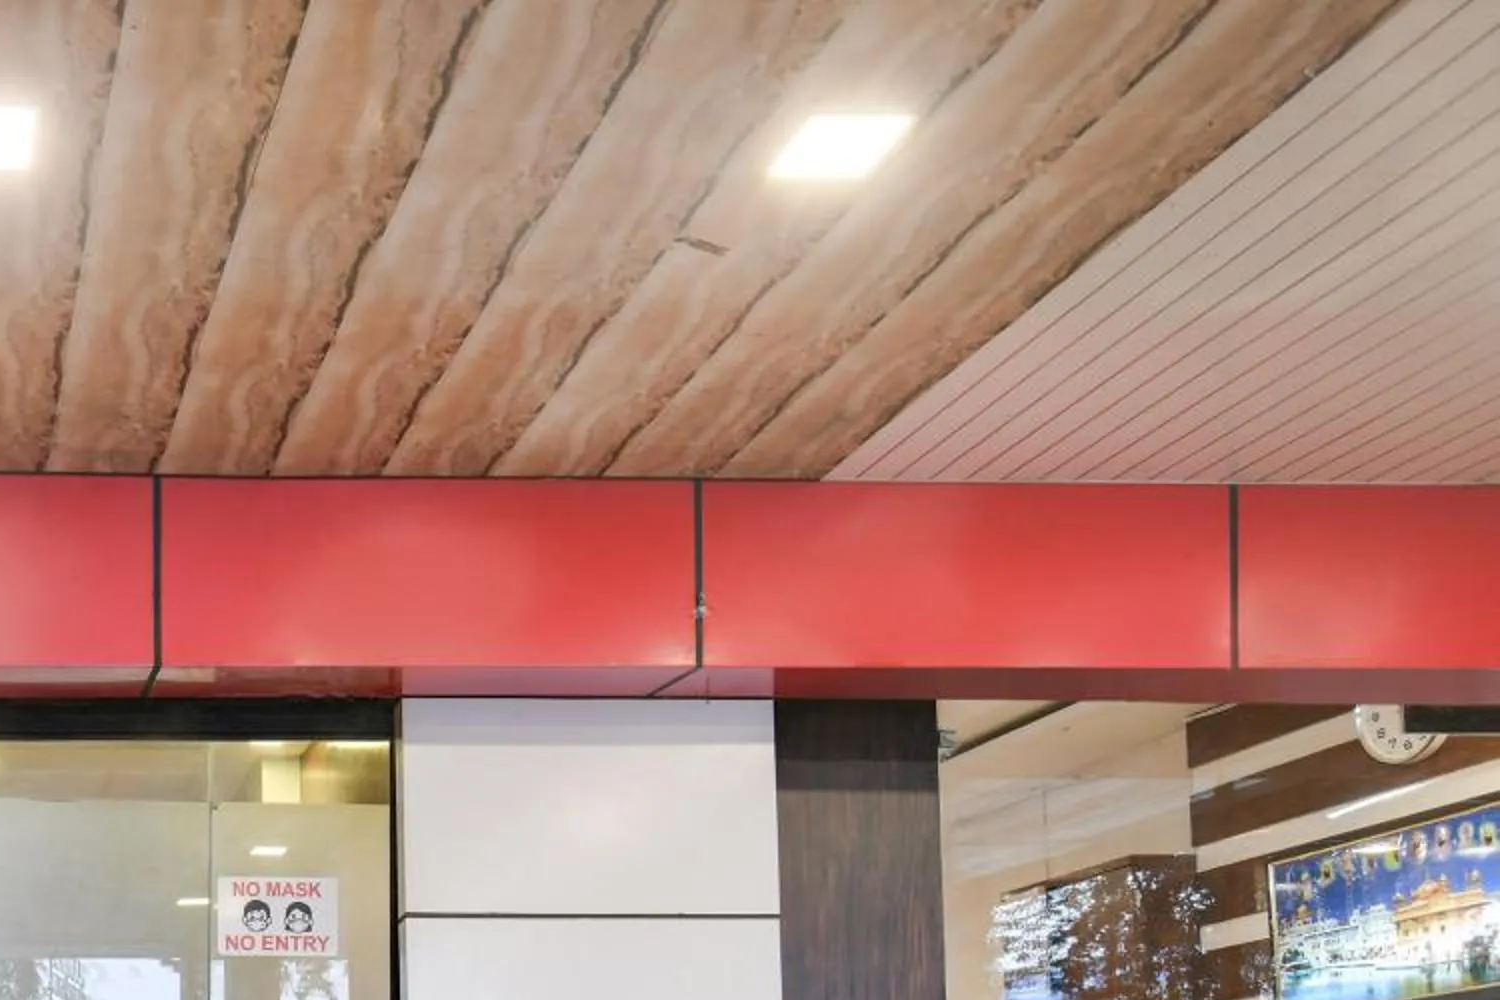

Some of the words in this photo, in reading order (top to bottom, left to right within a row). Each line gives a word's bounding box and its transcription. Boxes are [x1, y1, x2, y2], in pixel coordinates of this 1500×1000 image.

[232, 881, 260, 897] NO
[266, 881, 323, 898] MASK
[225, 935, 256, 951] NO
[261, 935, 330, 952] ENTRY
